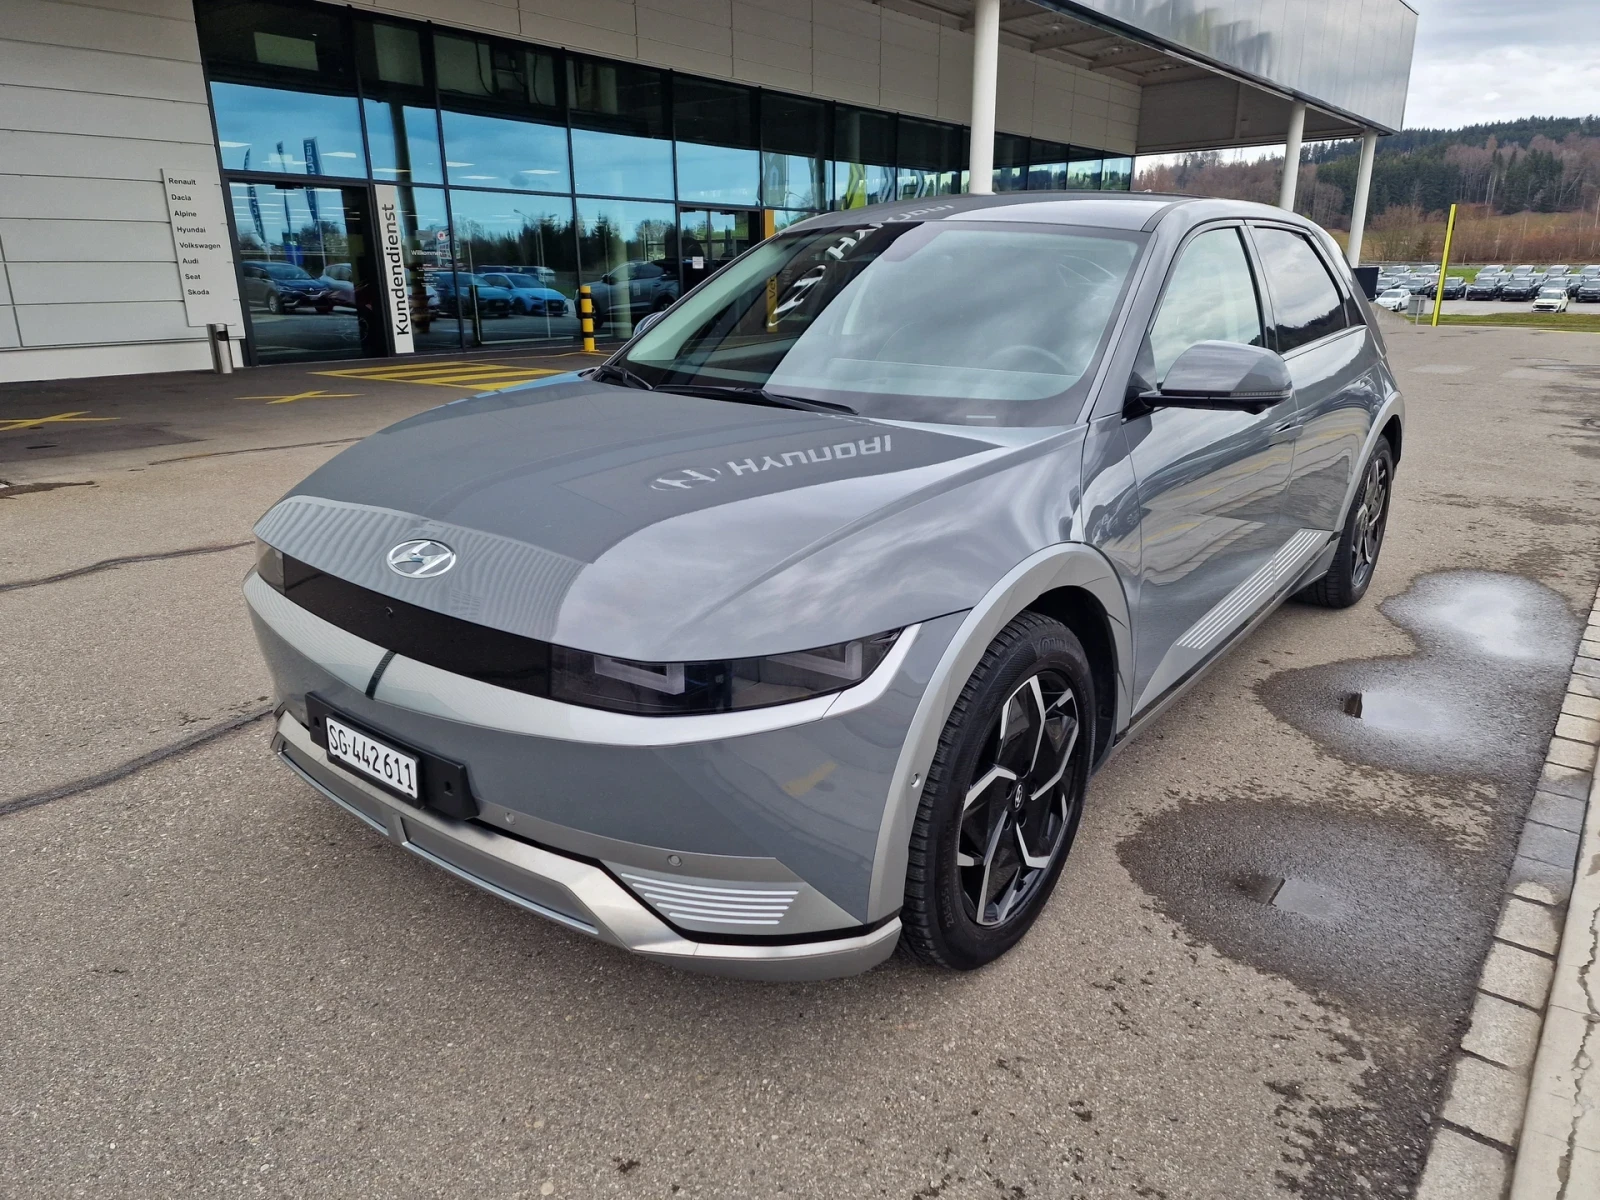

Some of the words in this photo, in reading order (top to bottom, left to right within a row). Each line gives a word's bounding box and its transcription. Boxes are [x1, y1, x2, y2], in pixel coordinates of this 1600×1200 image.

[168, 177, 197, 186] Renault
[171, 193, 192, 202] Dacia
[174, 210, 197, 218] Alpine
[177, 226, 206, 234] Hyundai
[179, 242, 221, 251] Volkswagen
[382, 203, 410, 336] Kundendienst
[187, 288, 210, 296] Skoda
